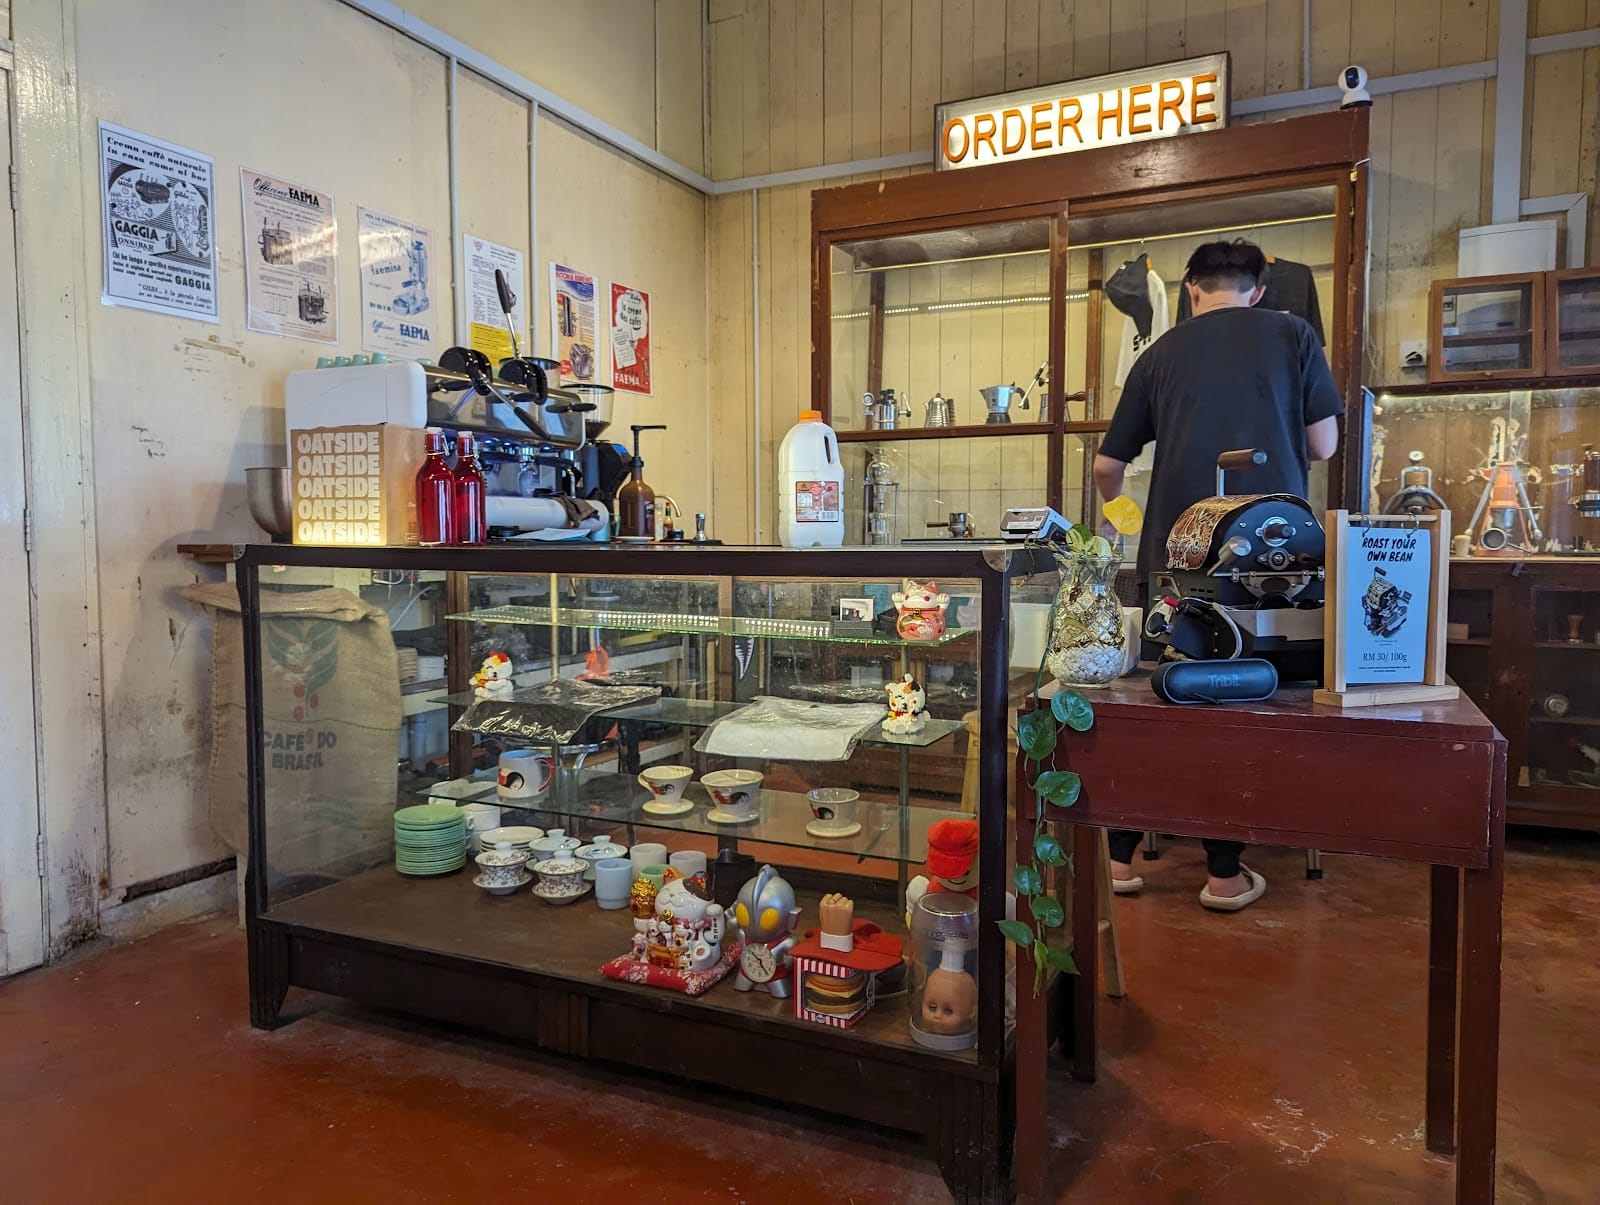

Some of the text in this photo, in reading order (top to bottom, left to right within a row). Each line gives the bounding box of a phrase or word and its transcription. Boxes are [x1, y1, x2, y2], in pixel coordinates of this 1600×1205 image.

[943, 73, 1217, 163] ORDER HERE
[107, 136, 139, 152] Crema
[168, 158, 206, 173] naturale
[122, 152, 144, 163] casa
[149, 160, 174, 172] come
[178, 168, 187, 176] al
[191, 171, 207, 182] bar
[288, 187, 320, 207] FAEMA
[115, 220, 160, 242] GAGGIA
[175, 276, 211, 292] GAGGIA
[400, 323, 430, 342] FAEMA
[614, 372, 640, 387] FAEMA
[297, 431, 380, 454] OATSIDE
[297, 454, 381, 477] OATSIDE
[297, 476, 381, 498] OATSIDE
[298, 499, 381, 520] OATSIDE
[298, 521, 381, 544] OATSIDE
[1362, 537, 1416, 550] ROAST YOUR
[1367, 551, 1414, 562] OWN BEAN
[1362, 652, 1375, 662] RM
[1390, 652, 1408, 662] 100g
[1208, 674, 1240, 688] Tribit
[318, 731, 337, 749] DO
[271, 752, 325, 771] BRASIL
